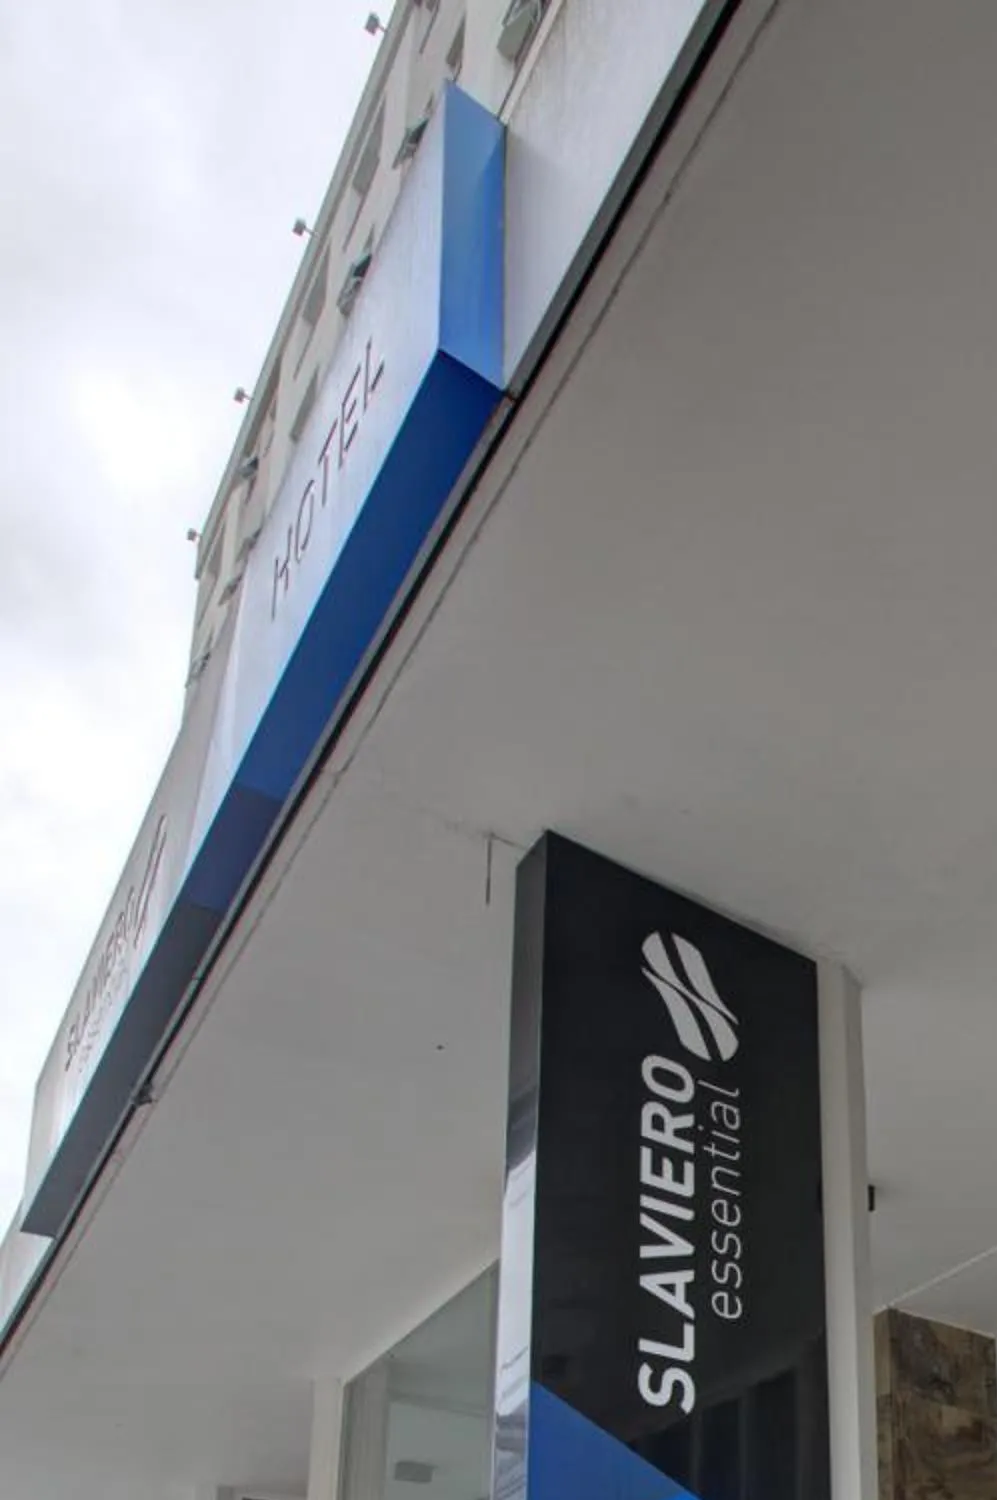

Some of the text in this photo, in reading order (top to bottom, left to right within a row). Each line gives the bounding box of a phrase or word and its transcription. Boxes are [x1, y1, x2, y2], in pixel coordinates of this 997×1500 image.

[271, 335, 385, 620] HOTEL
[637, 1054, 696, 1415] SLAVIERO
[697, 1079, 743, 1320] essential
